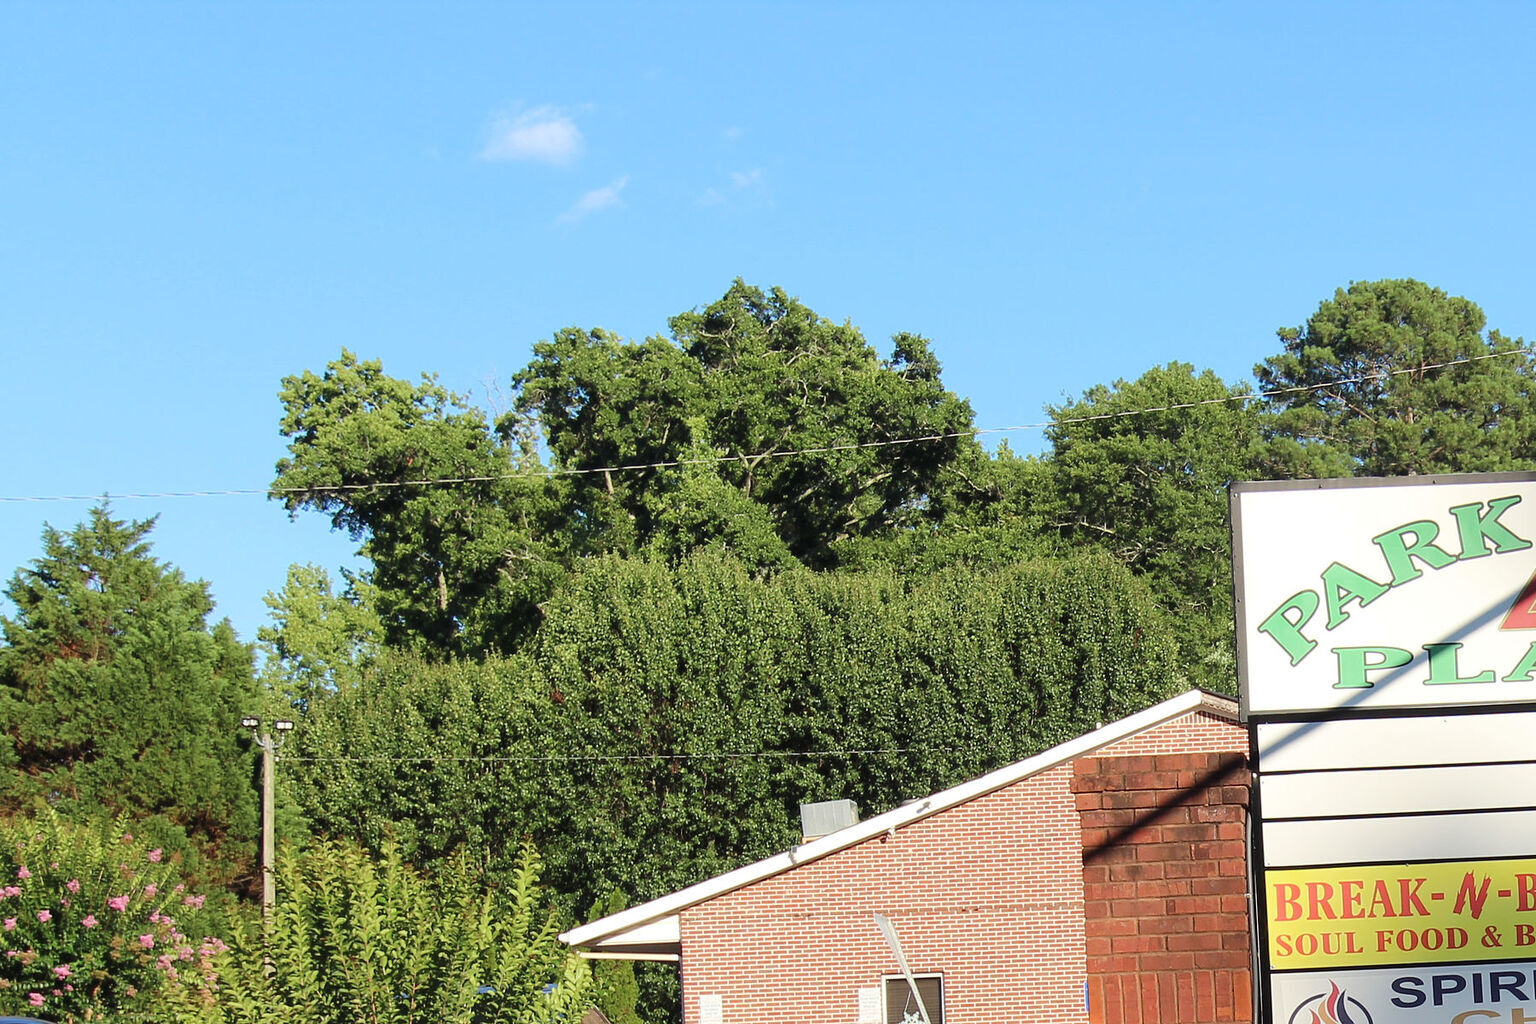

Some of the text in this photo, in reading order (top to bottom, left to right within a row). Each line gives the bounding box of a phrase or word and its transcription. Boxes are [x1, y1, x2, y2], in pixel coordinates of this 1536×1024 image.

[1258, 494, 1533, 667] PARK
[1276, 931, 1364, 957] SOUL
[1376, 927, 1469, 953] FOOD
[1481, 925, 1503, 948] &
